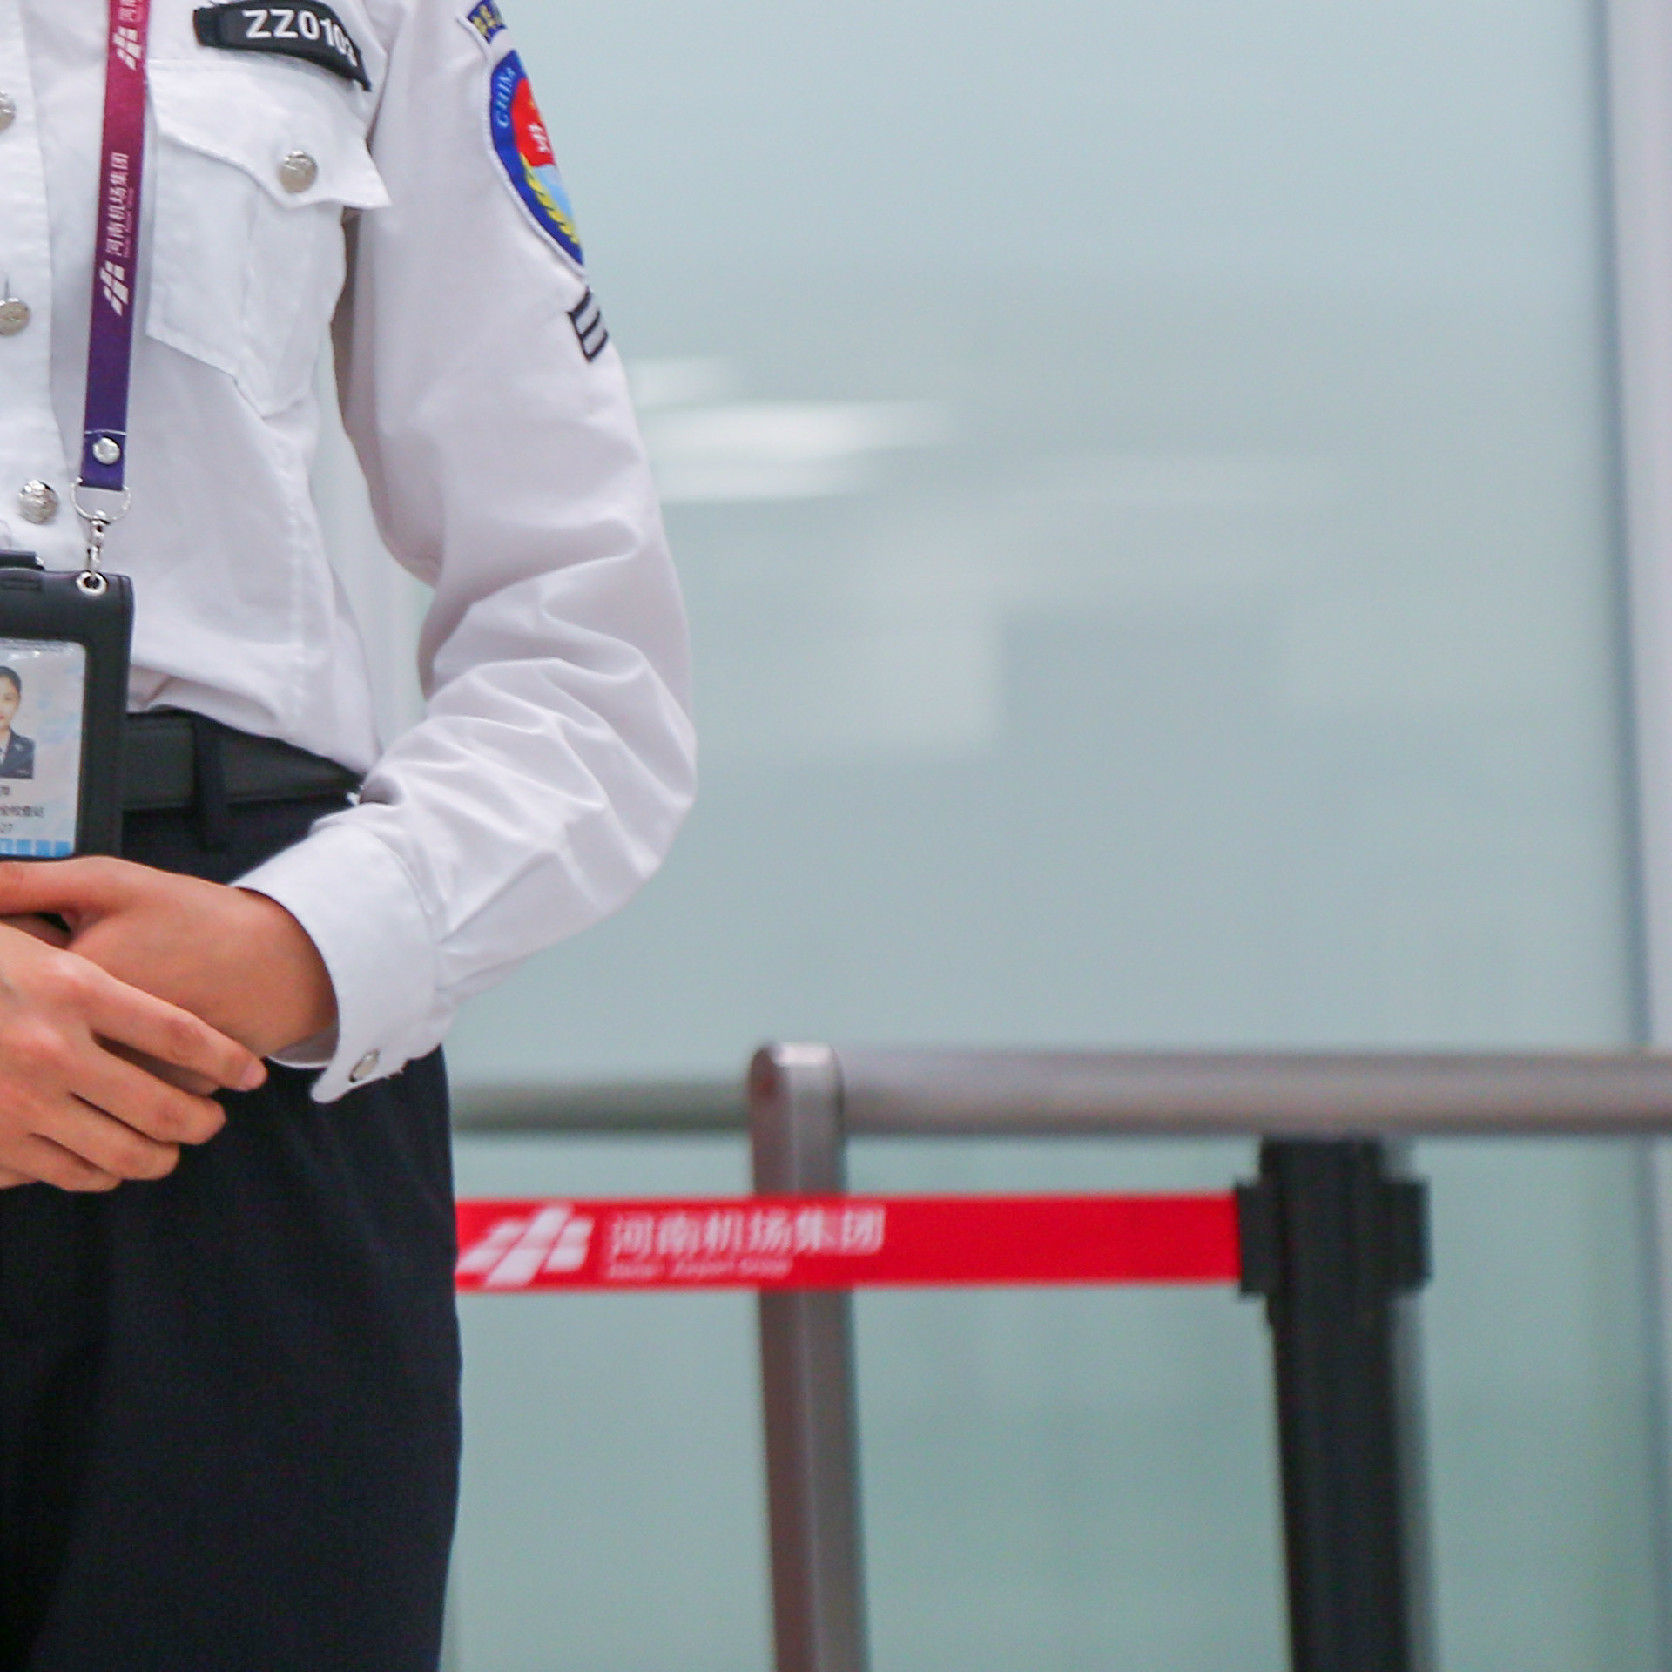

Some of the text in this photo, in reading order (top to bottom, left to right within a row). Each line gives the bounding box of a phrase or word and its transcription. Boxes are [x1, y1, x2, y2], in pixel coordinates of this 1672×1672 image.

[105, 151, 130, 257] 河南机场集团
[609, 1207, 886, 1262] 河南机场集团
